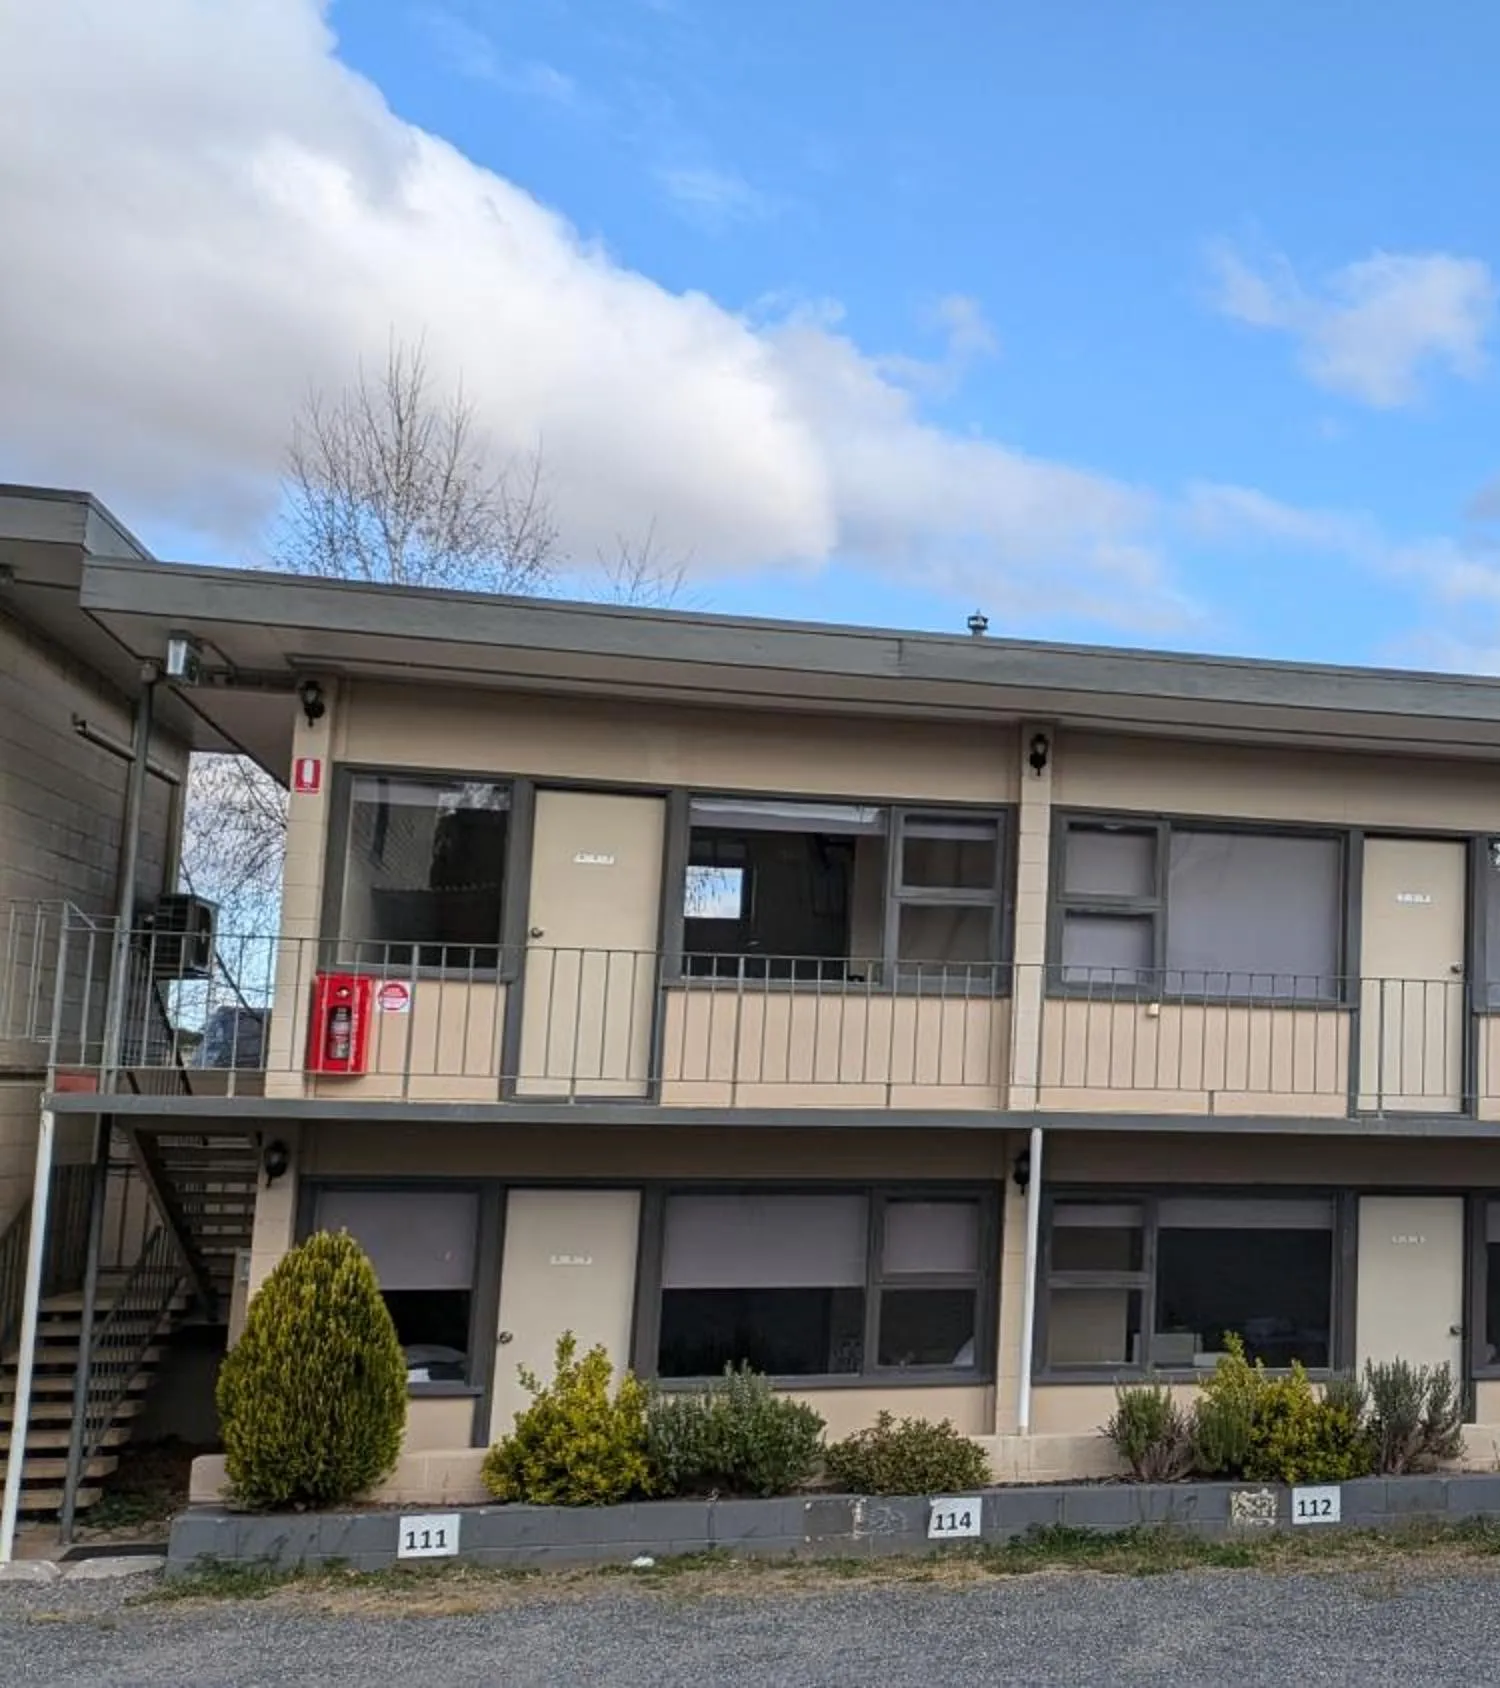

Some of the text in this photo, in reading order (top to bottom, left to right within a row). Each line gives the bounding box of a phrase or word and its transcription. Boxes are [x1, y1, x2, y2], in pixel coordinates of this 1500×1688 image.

[1298, 1499, 1332, 1516] 112
[934, 1511, 972, 1531] 114
[405, 1529, 447, 1550] 111
